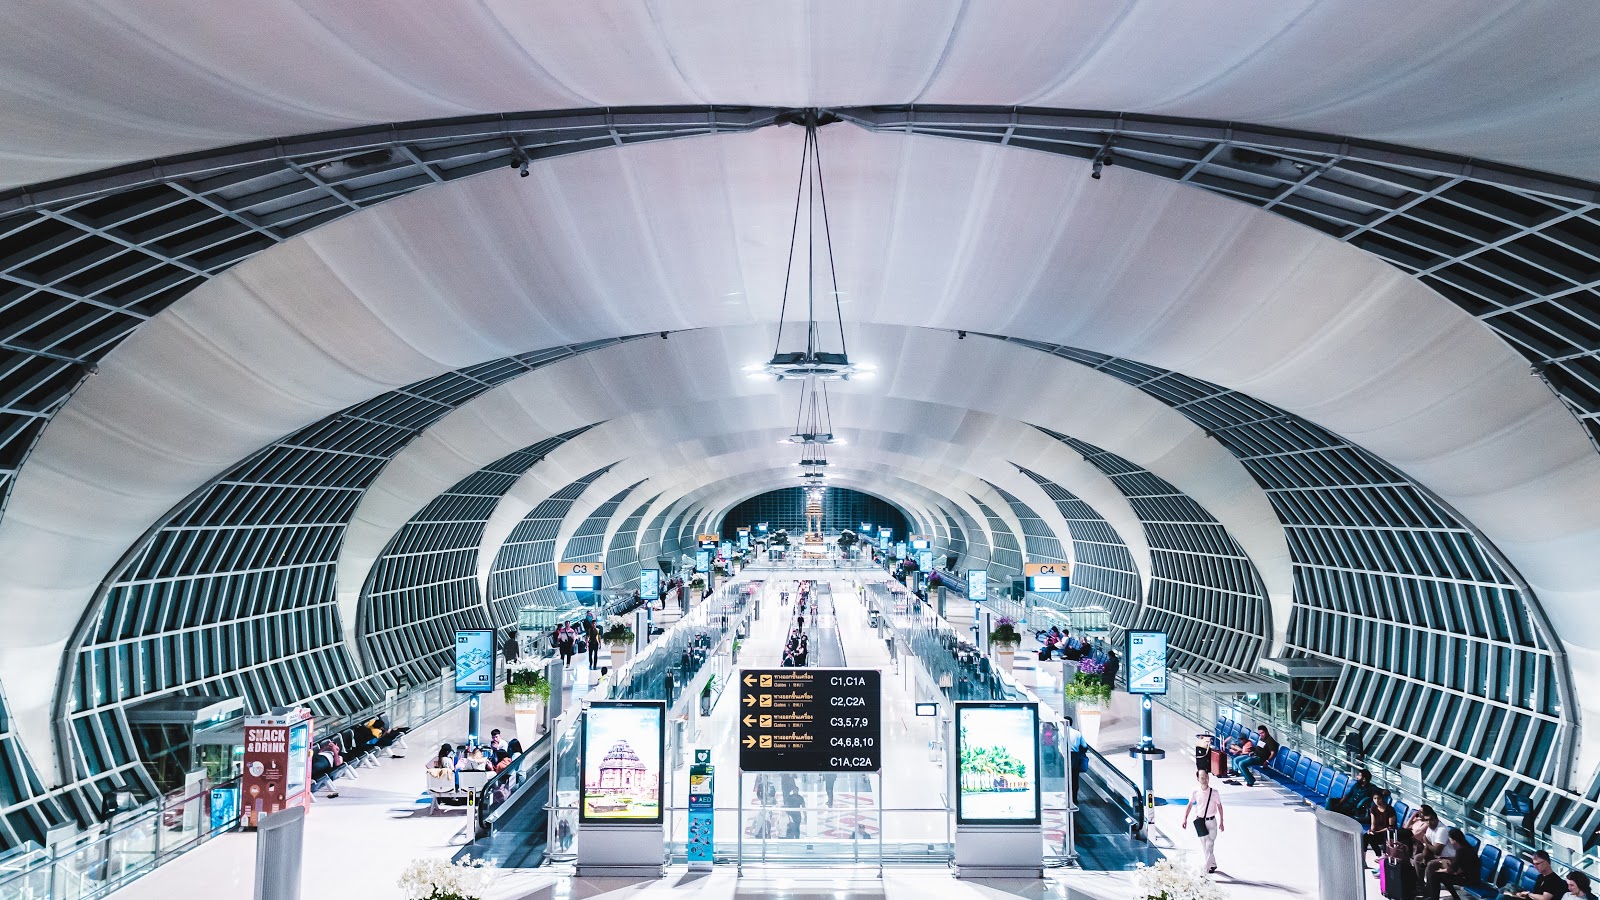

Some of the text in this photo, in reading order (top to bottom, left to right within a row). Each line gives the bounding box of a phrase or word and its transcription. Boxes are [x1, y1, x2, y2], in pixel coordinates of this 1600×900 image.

[572, 564, 588, 574] C3
[1040, 565, 1055, 575] C4
[830, 676, 866, 687] C1,C1A
[830, 697, 866, 707] C2,C2A
[830, 717, 869, 728] C3,5,7,9
[248, 729, 286, 742] SNACK
[247, 742, 286, 753] &DRINK
[830, 737, 874, 748] C4,6,8,10
[830, 757, 873, 768] C1A,C2A
